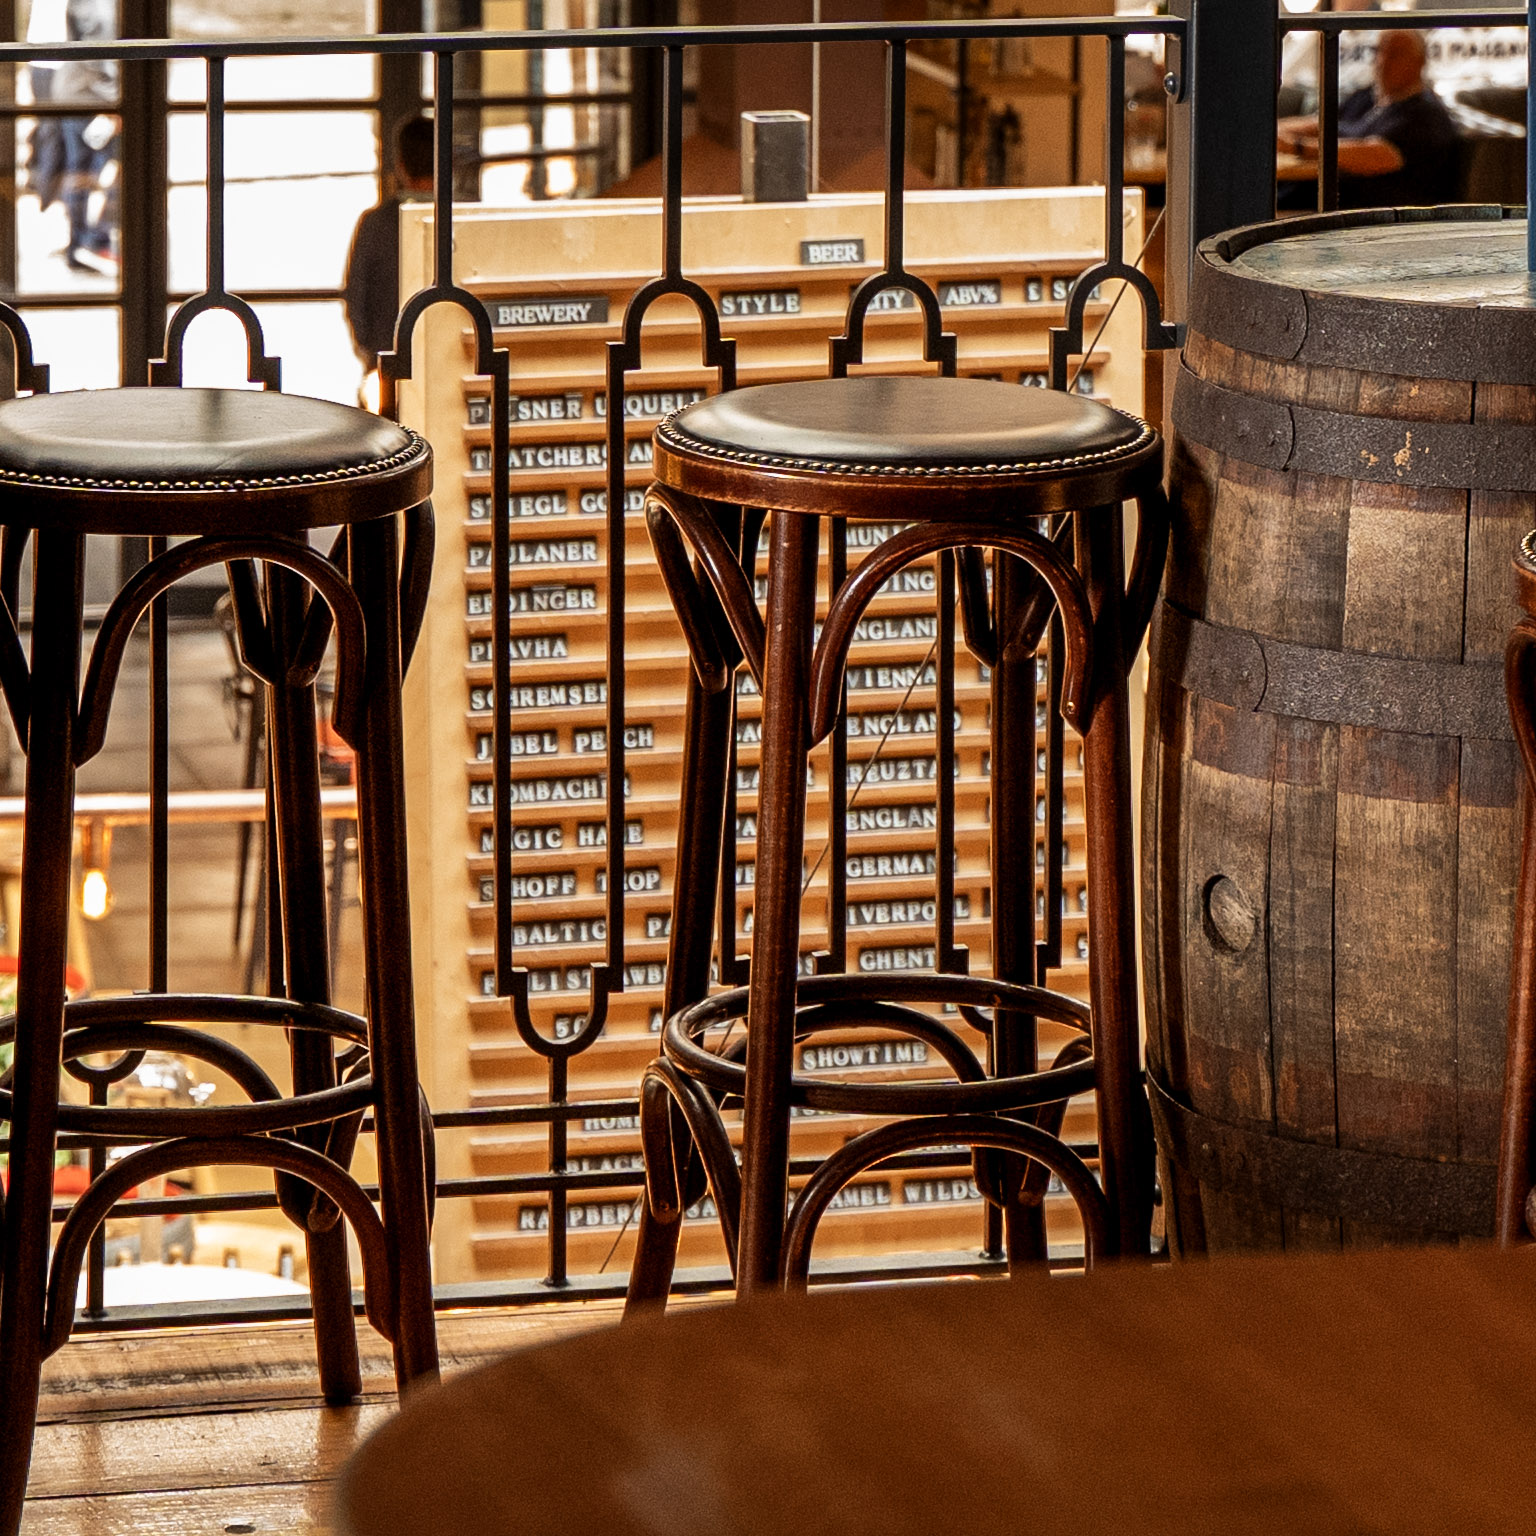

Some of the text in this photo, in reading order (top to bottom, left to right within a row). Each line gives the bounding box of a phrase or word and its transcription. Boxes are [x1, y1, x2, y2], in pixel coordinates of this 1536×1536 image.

[809, 242, 858, 263] BEER
[721, 293, 800, 315] STYLE
[945, 284, 998, 306] ABV%
[497, 302, 591, 325] BREWERY
[470, 397, 582, 426] PSNER
[471, 442, 607, 470] TATCHER
[581, 492, 644, 513] GOD
[854, 618, 937, 641] NGLAN
[477, 728, 654, 761] JBEL PECH
[846, 807, 937, 831] ENGLAN
[481, 824, 644, 853] MGIC HAE
[846, 855, 958, 878] GERMAN
[848, 899, 969, 926] IVERPOL
[513, 919, 608, 946] BALTIC
[802, 1043, 928, 1071] SHOWTIME
